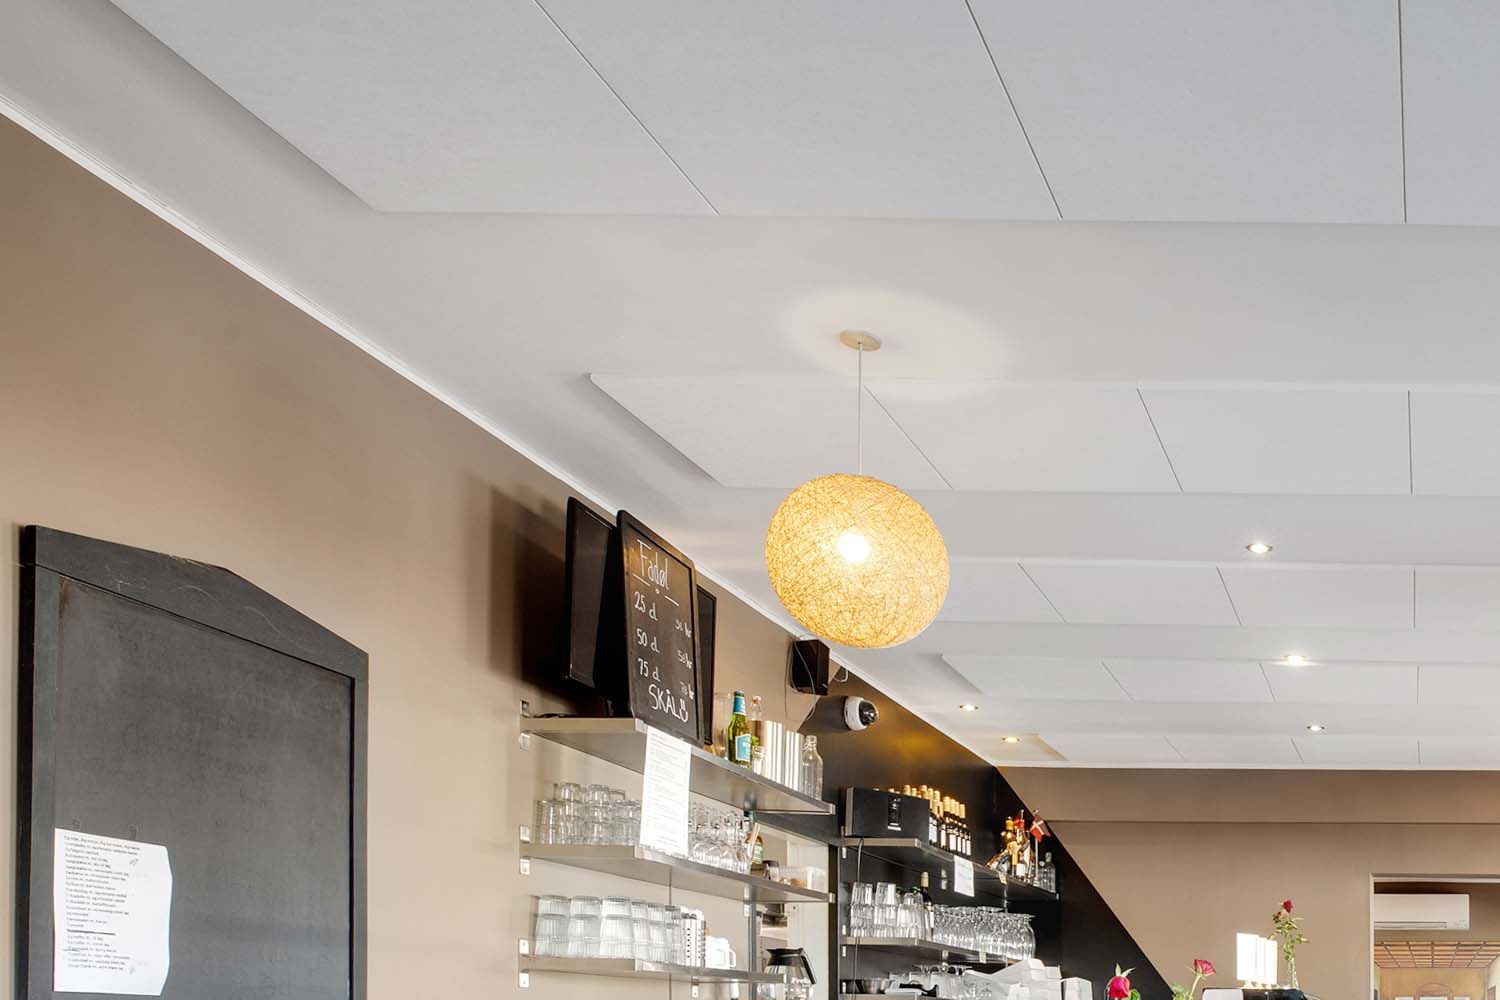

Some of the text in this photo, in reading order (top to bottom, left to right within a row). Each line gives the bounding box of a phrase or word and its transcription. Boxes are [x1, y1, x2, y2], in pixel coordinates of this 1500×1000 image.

[637, 539, 670, 590] Fadøl
[634, 591, 646, 614] 25
[636, 628, 648, 647] 50
[637, 657, 649, 678] 75
